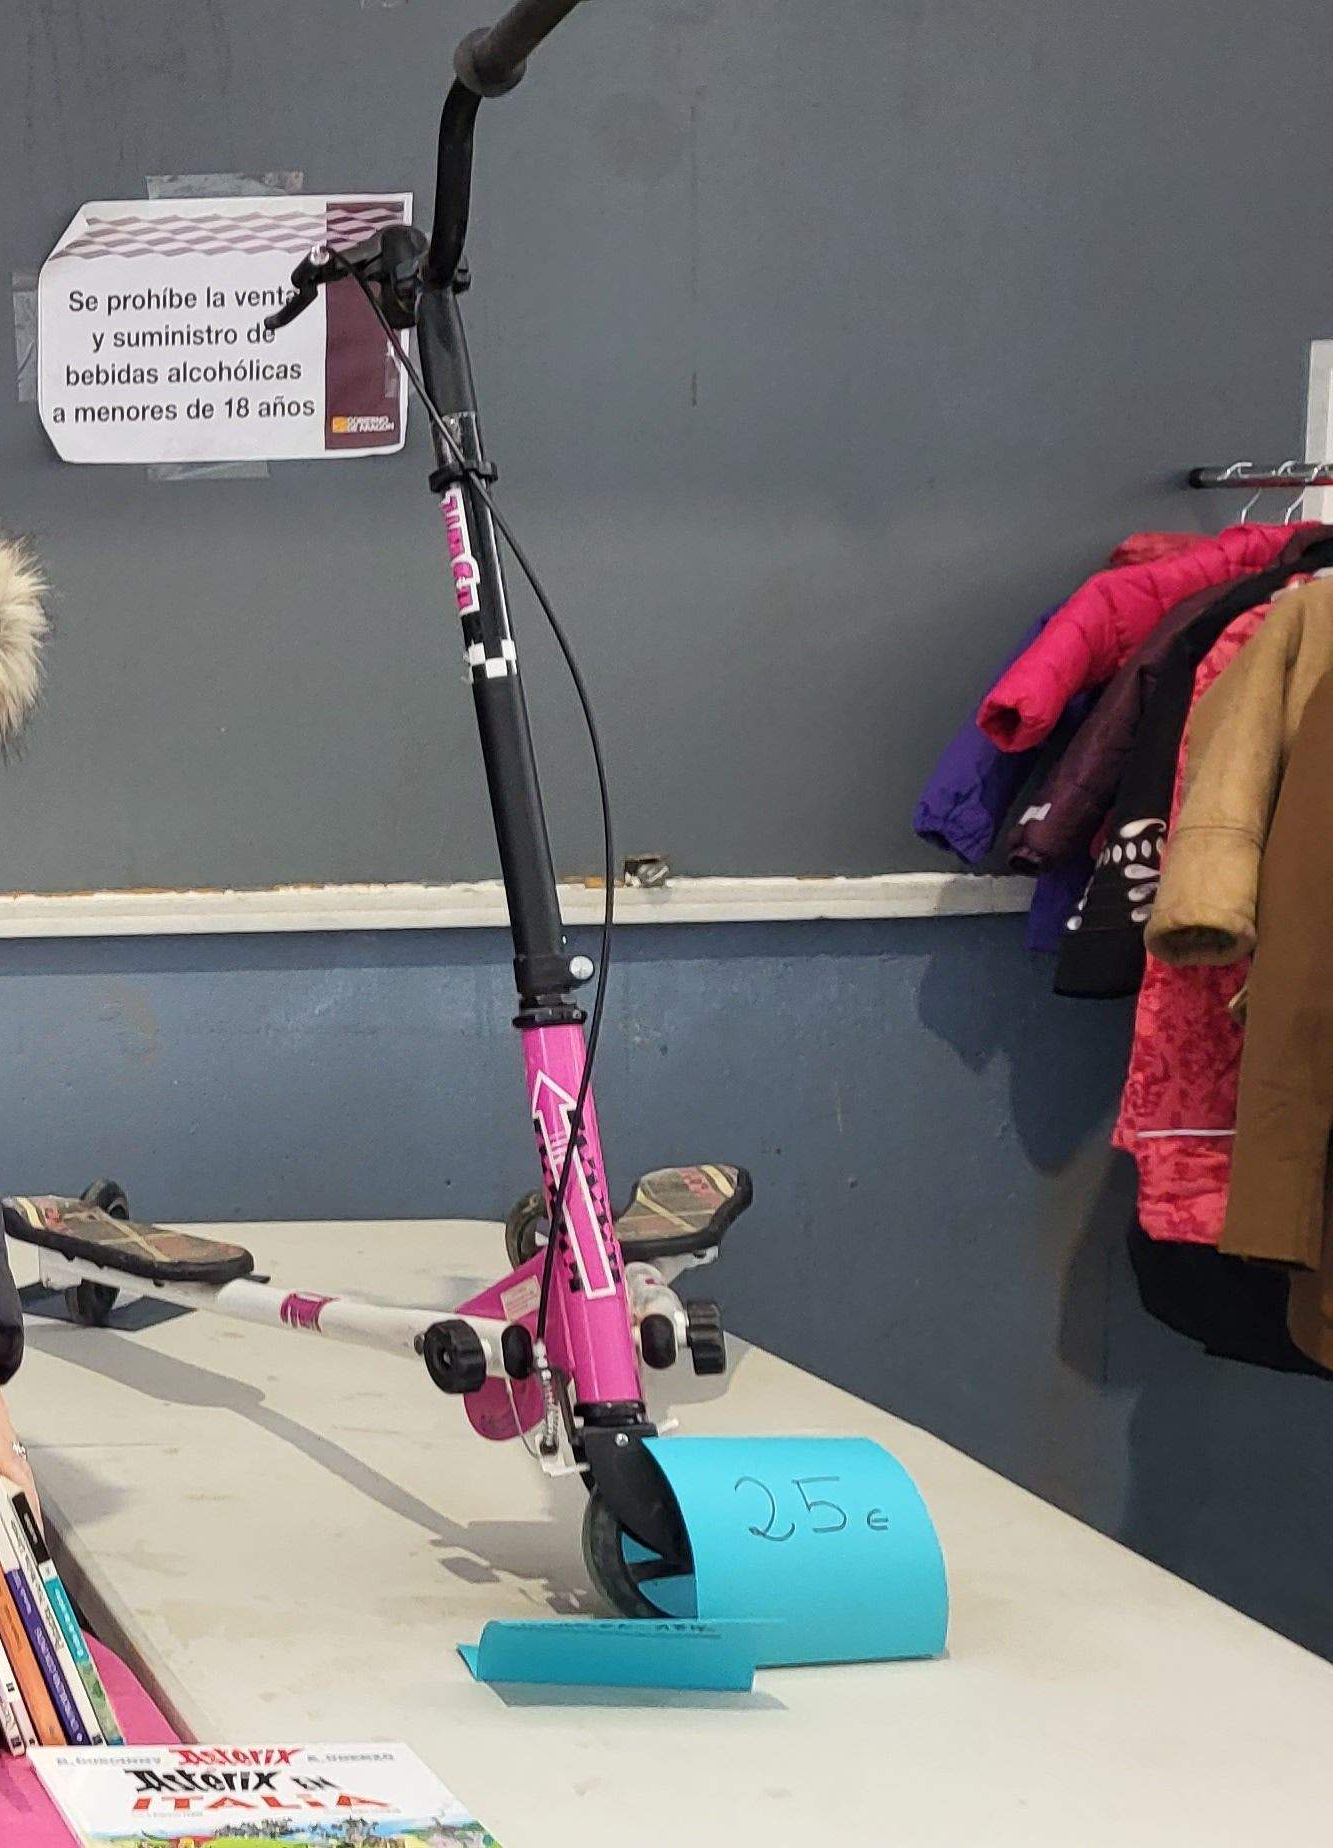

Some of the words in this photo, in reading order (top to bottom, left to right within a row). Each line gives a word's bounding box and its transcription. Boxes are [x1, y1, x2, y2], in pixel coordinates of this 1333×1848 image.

[68, 290, 98, 313] Se
[106, 286, 197, 317] prohíbe
[206, 286, 225, 309] la
[234, 286, 299, 309] venta
[92, 330, 104, 353] y
[113, 324, 238, 348] suministro
[246, 322, 276, 345] de
[66, 362, 158, 387] bebidas
[167, 358, 302, 384] alcohólicas
[52, 408, 65, 425] a
[74, 402, 179, 424] menores
[186, 398, 215, 421] de
[224, 397, 250, 419] 18
[257, 392, 316, 419] años
[132, 1795, 392, 1811] ITALIA
